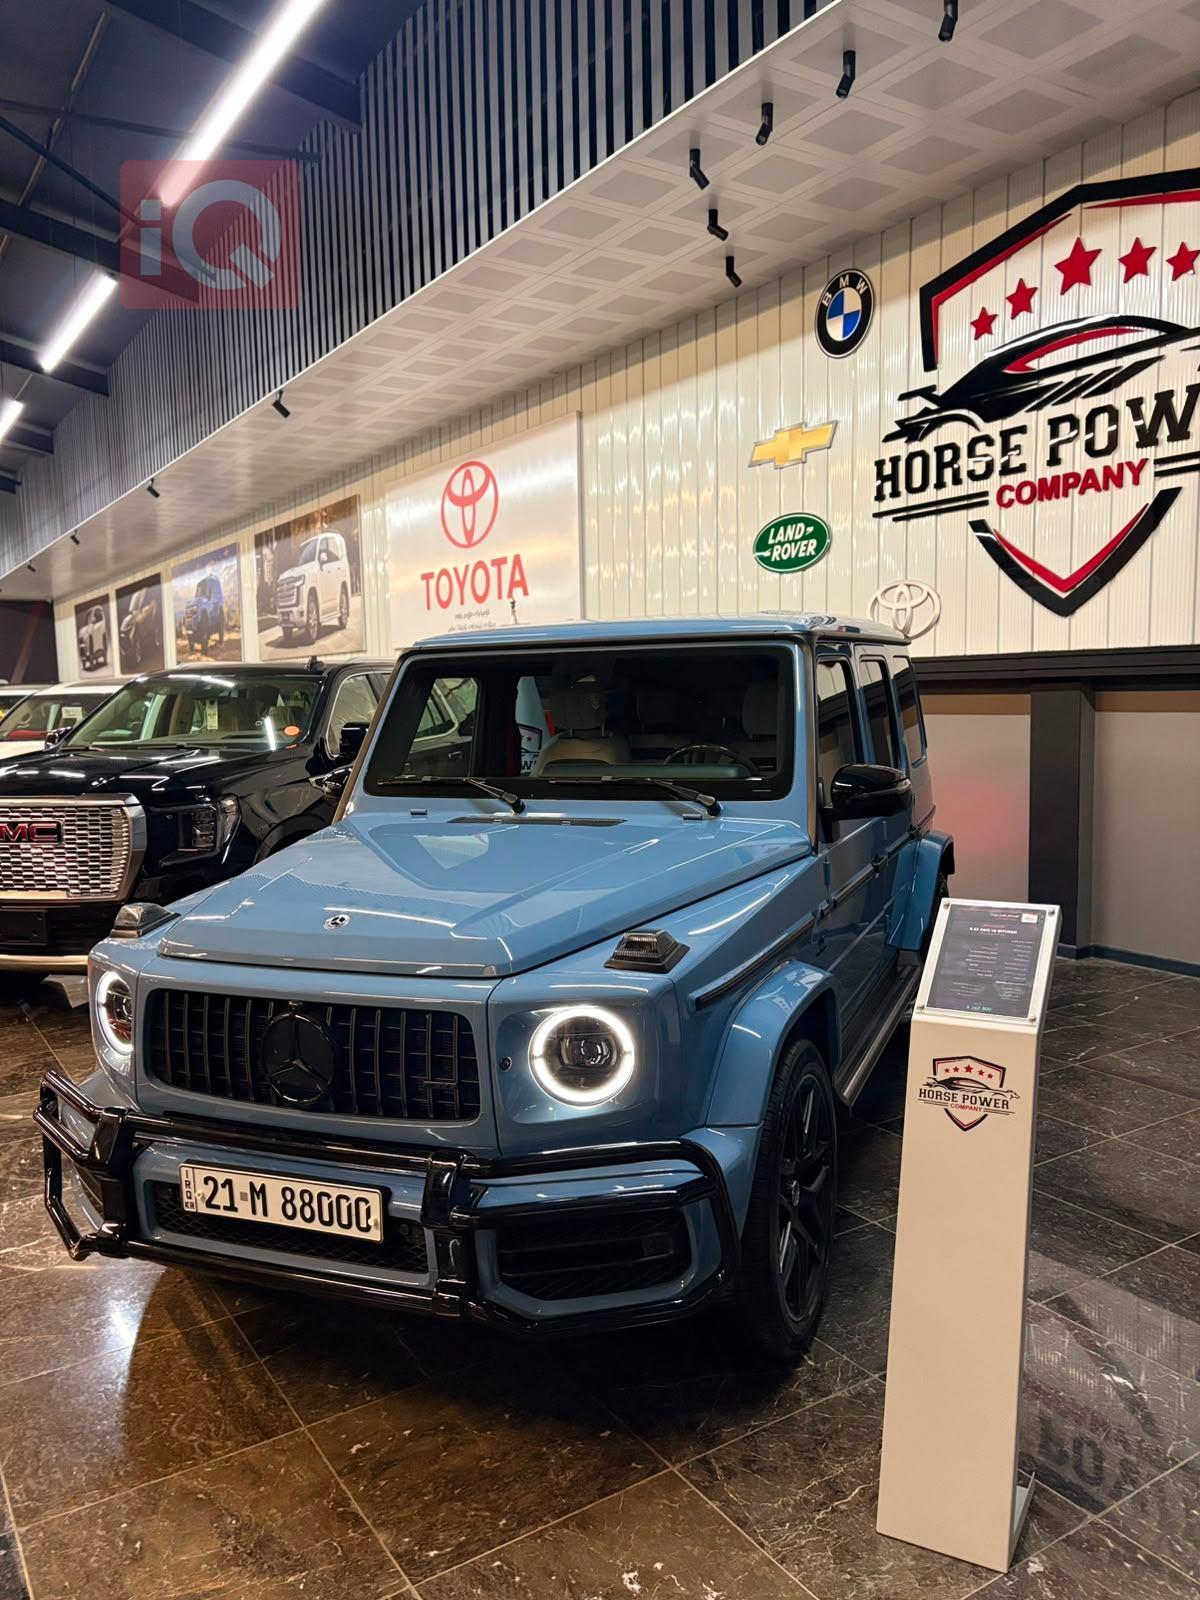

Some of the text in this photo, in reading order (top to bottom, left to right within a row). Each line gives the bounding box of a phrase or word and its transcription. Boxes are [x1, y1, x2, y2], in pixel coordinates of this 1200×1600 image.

[821, 274, 868, 307] BMW
[873, 424, 1028, 502] HORSE
[995, 457, 1149, 509] COMPANY
[771, 538, 818, 562] ROVER
[420, 553, 529, 611] TOYOTA
[918, 1088, 1010, 1110] HORSE POWER
[950, 1103, 983, 1112] COMPANY
[185, 1201, 195, 1210] KR
[203, 1175, 372, 1233] 21 M 88000
